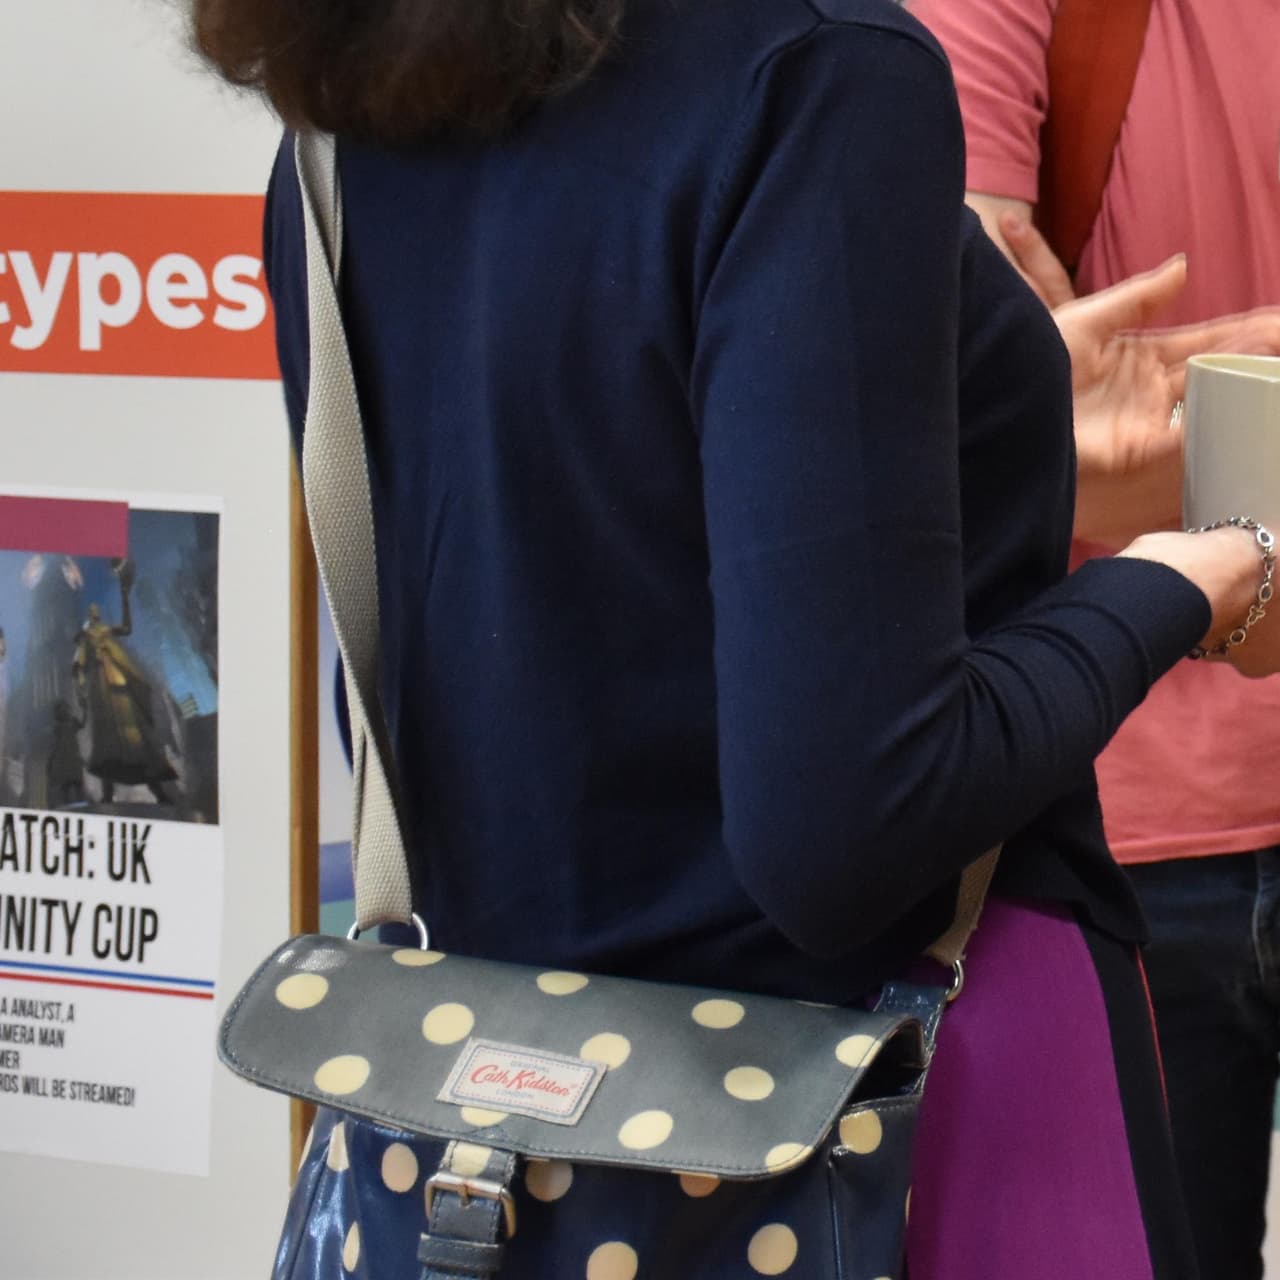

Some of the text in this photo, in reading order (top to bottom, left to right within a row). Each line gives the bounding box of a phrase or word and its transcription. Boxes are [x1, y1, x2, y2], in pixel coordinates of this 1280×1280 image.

[0, 812, 152, 884] ATCH: UK
[0, 893, 159, 963] NITY CUP
[11, 998, 65, 1023] ANALYST,
[67, 1003, 75, 1023] A
[39, 1026, 65, 1048] MAN
[22, 1076, 48, 1097] WILL
[52, 1079, 67, 1099] BE
[69, 1081, 136, 1108] STREAMED!
[471, 1064, 509, 1084] Cath
[506, 1070, 570, 1097] Kidston
